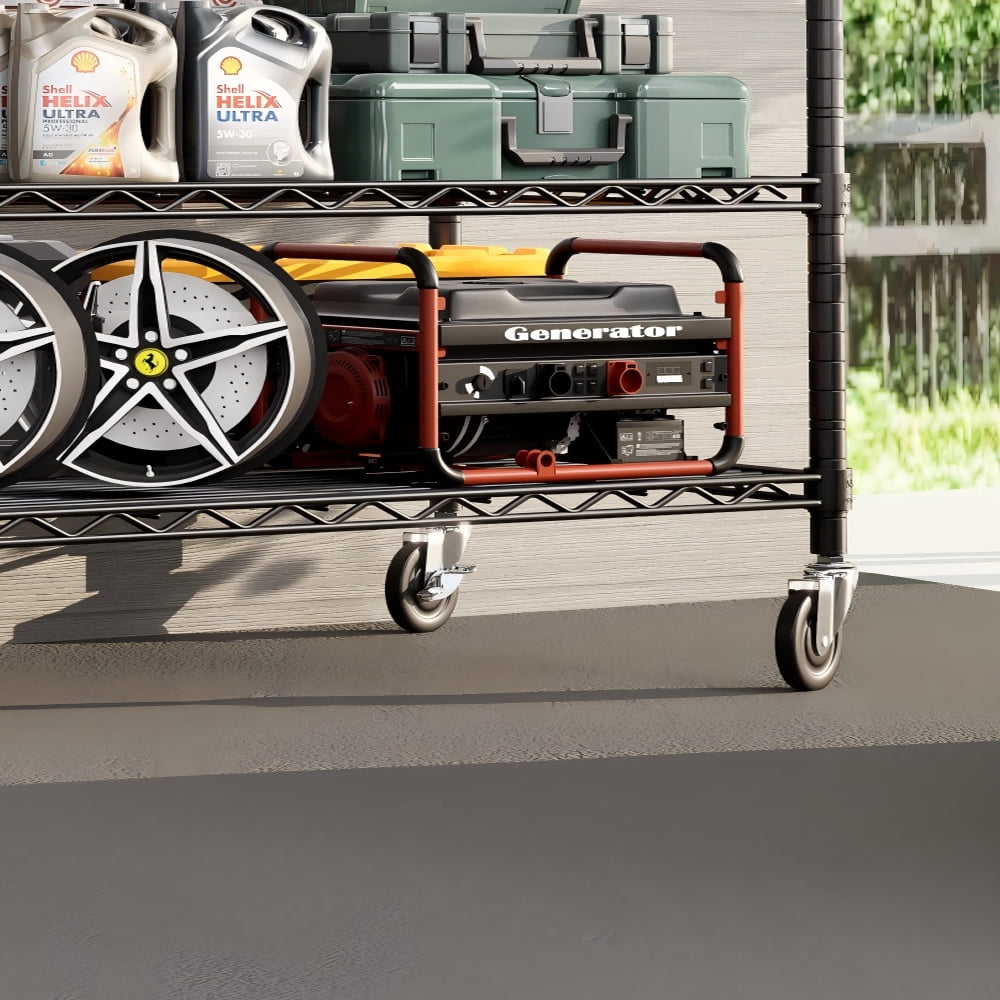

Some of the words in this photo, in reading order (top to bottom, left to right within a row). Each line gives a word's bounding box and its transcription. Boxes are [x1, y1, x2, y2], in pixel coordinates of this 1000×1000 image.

[42, 85, 72, 93] Shell
[217, 84, 244, 93] Shell
[42, 94, 110, 108] HELIX
[216, 94, 281, 109] HELIX
[42, 109, 100, 119] ULTRA
[216, 110, 278, 122] ULTRA
[43, 124, 78, 132] 5W-30
[217, 130, 252, 139] 5W-30
[504, 324, 683, 341] Generator
